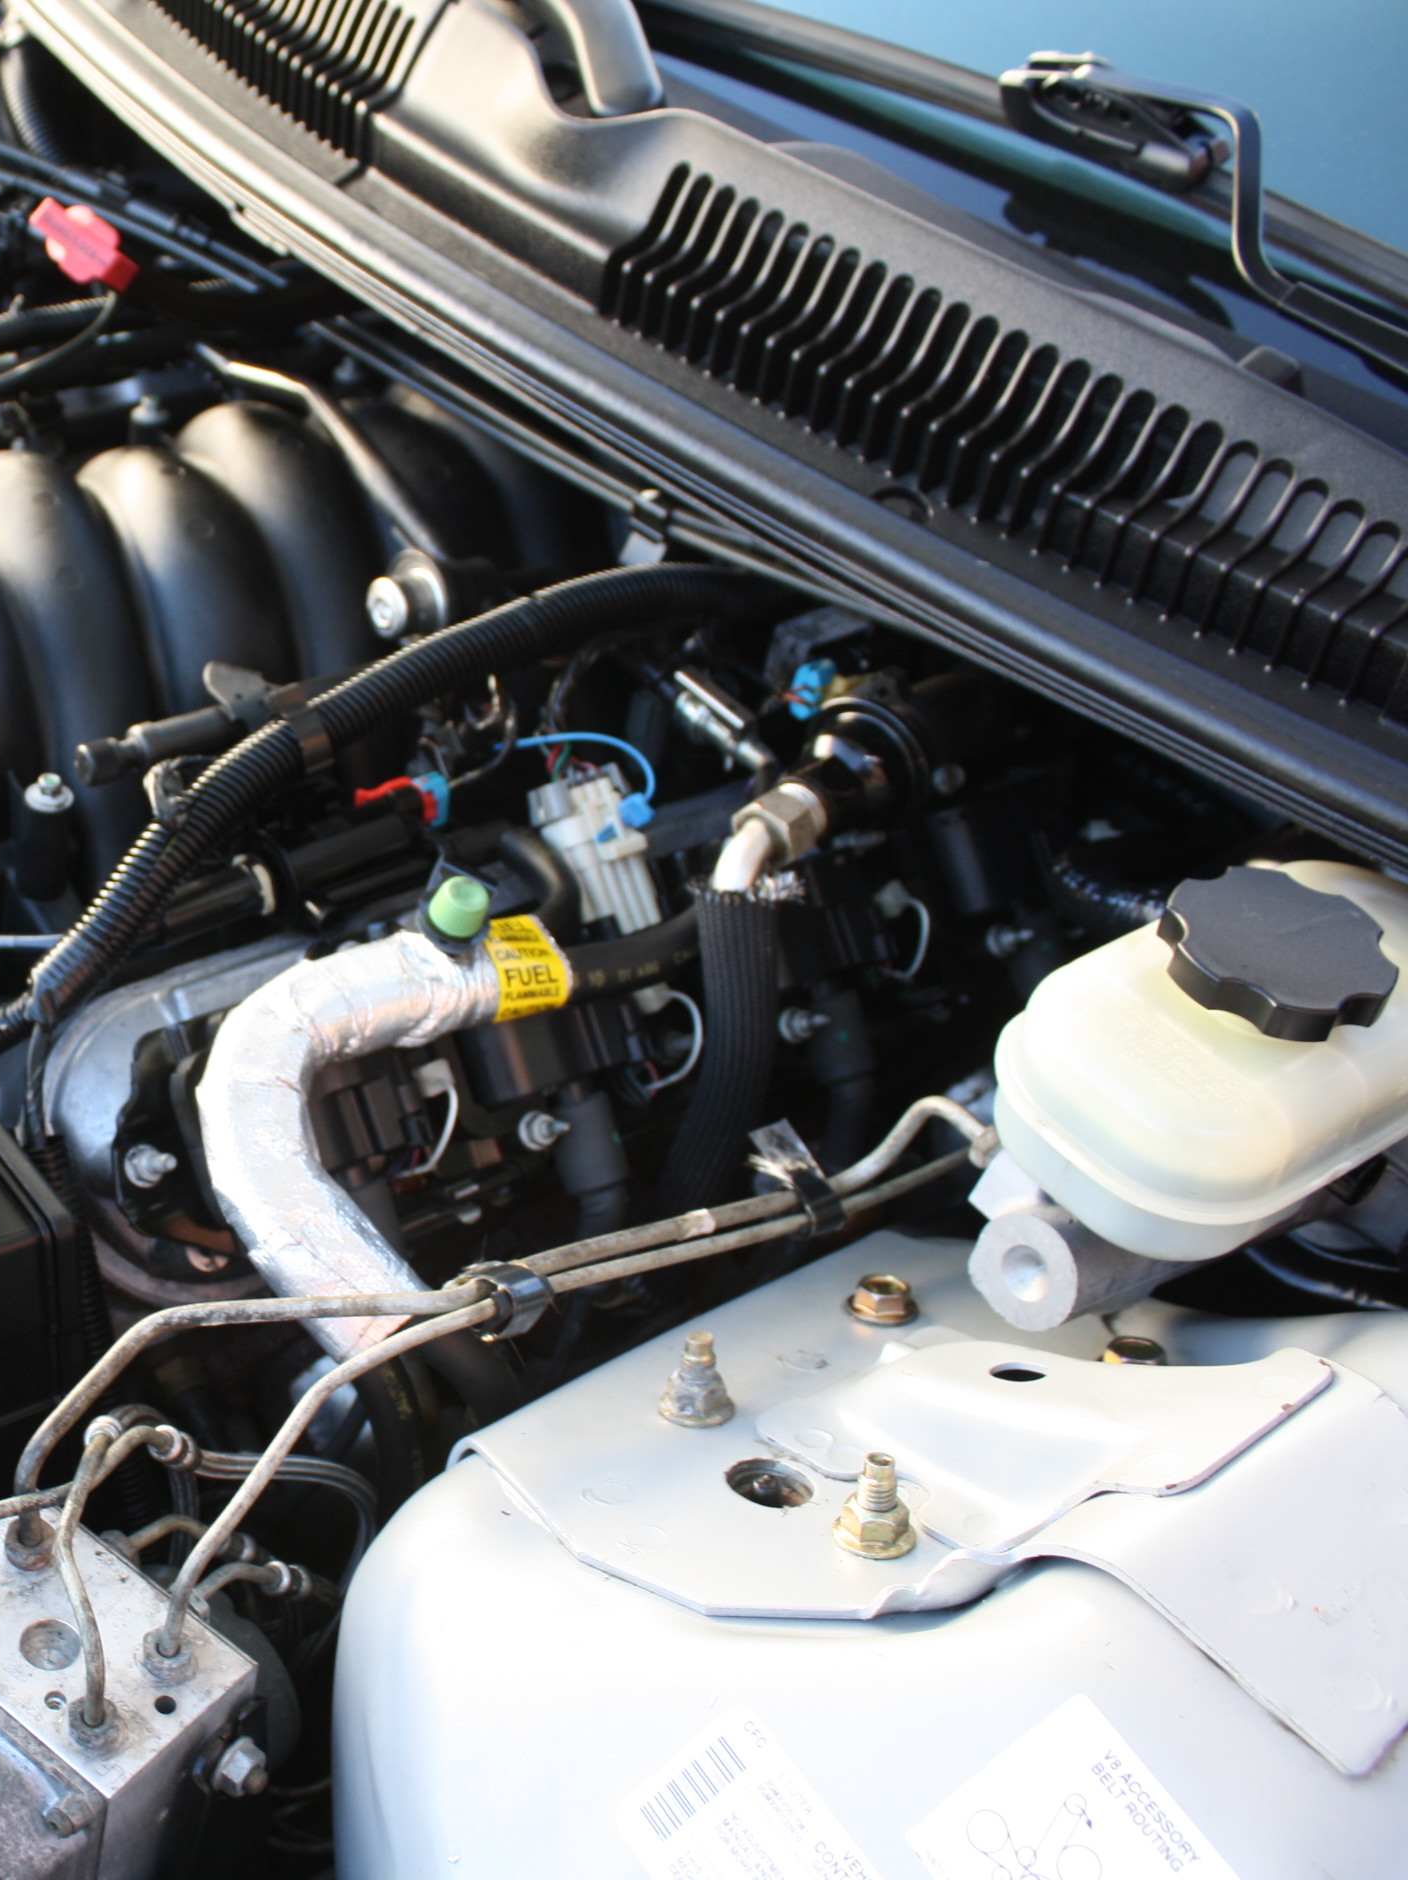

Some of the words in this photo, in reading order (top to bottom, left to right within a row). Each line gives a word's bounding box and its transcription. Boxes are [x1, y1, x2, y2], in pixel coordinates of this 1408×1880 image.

[496, 947, 551, 961] CAUTION
[505, 964, 559, 987] FUEL
[505, 986, 560, 999] FLAMMABLE
[741, 1718, 768, 1750] CFC
[1090, 1761, 1127, 1802] BELT
[1122, 1800, 1186, 1874] ROUTING
[1101, 1748, 1123, 1771] V8
[1118, 1769, 1201, 1866] ACCESSORY
